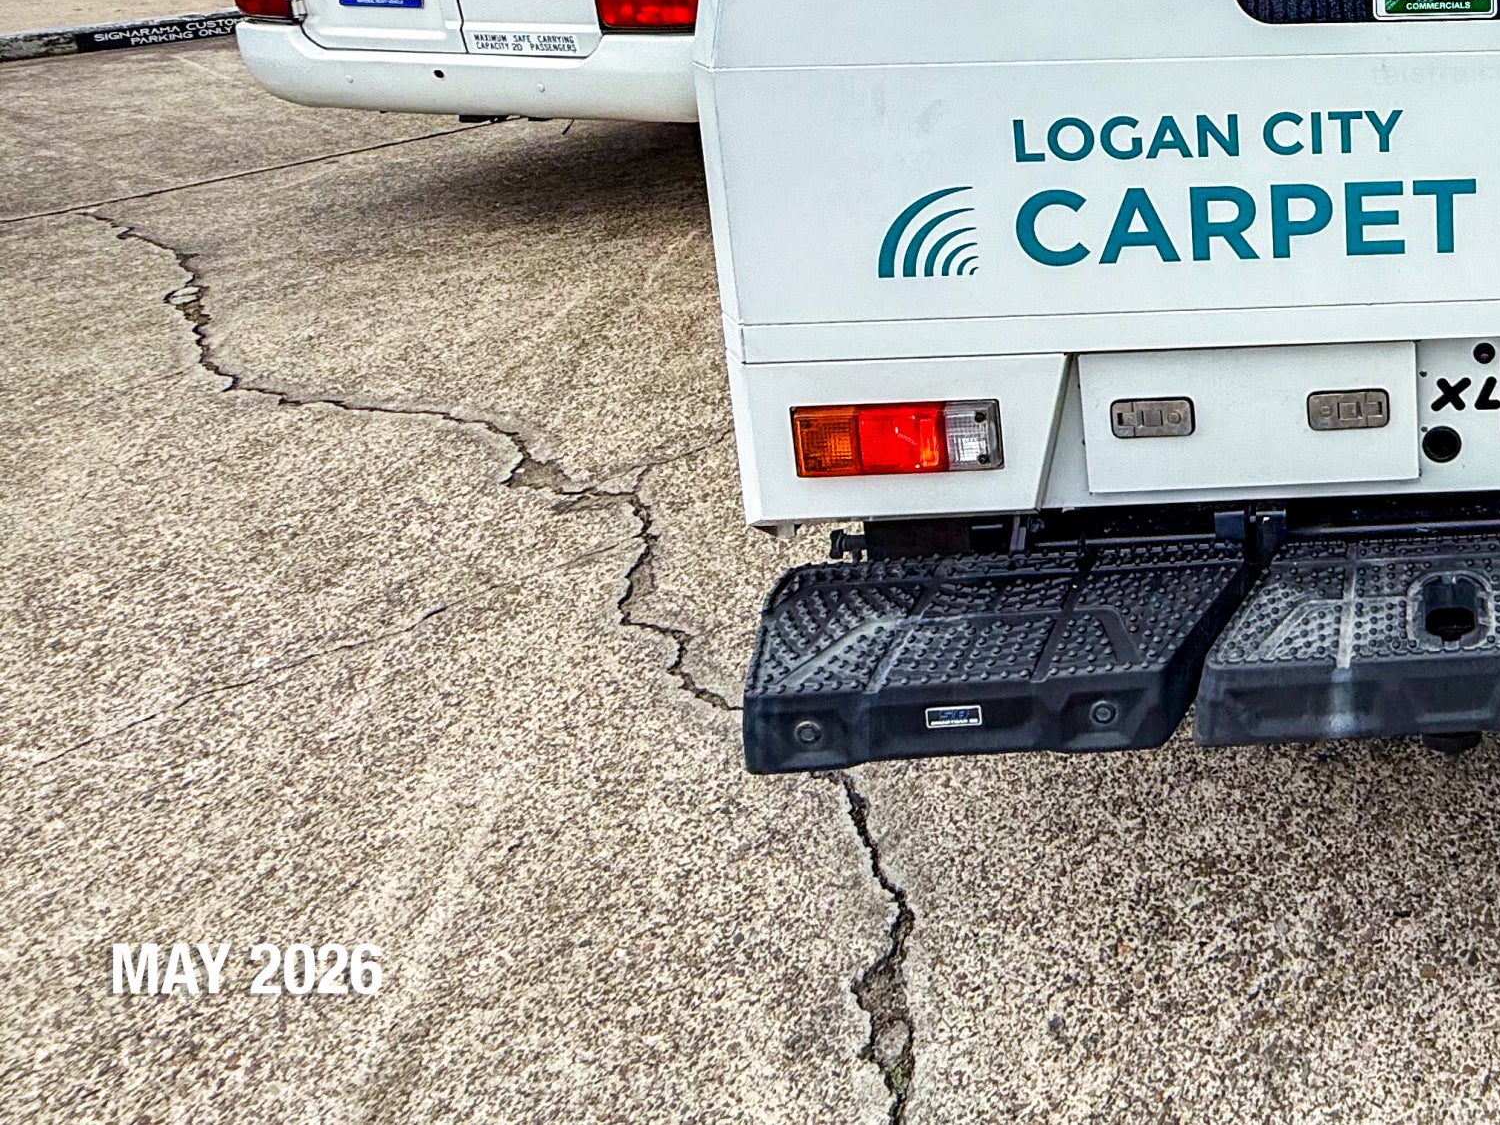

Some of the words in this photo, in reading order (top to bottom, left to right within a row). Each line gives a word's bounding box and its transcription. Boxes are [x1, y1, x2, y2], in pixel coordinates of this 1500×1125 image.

[1406, 1, 1471, 11] COMMERCIALS
[93, 25, 181, 42] SIGNARAMA
[186, 17, 249, 31] CUSTOM
[130, 31, 194, 46] PARKING
[199, 26, 232, 37] ONLY
[474, 33, 507, 42] MAXIMUM
[513, 34, 531, 43] SAFE
[537, 35, 575, 44] CARRYING
[476, 42, 509, 50] CAPACITY
[530, 43, 577, 53] PASSENGERS
[1012, 113, 1240, 163] LOGAN
[1262, 109, 1404, 156] CITY
[1015, 178, 1477, 267] CARPET
